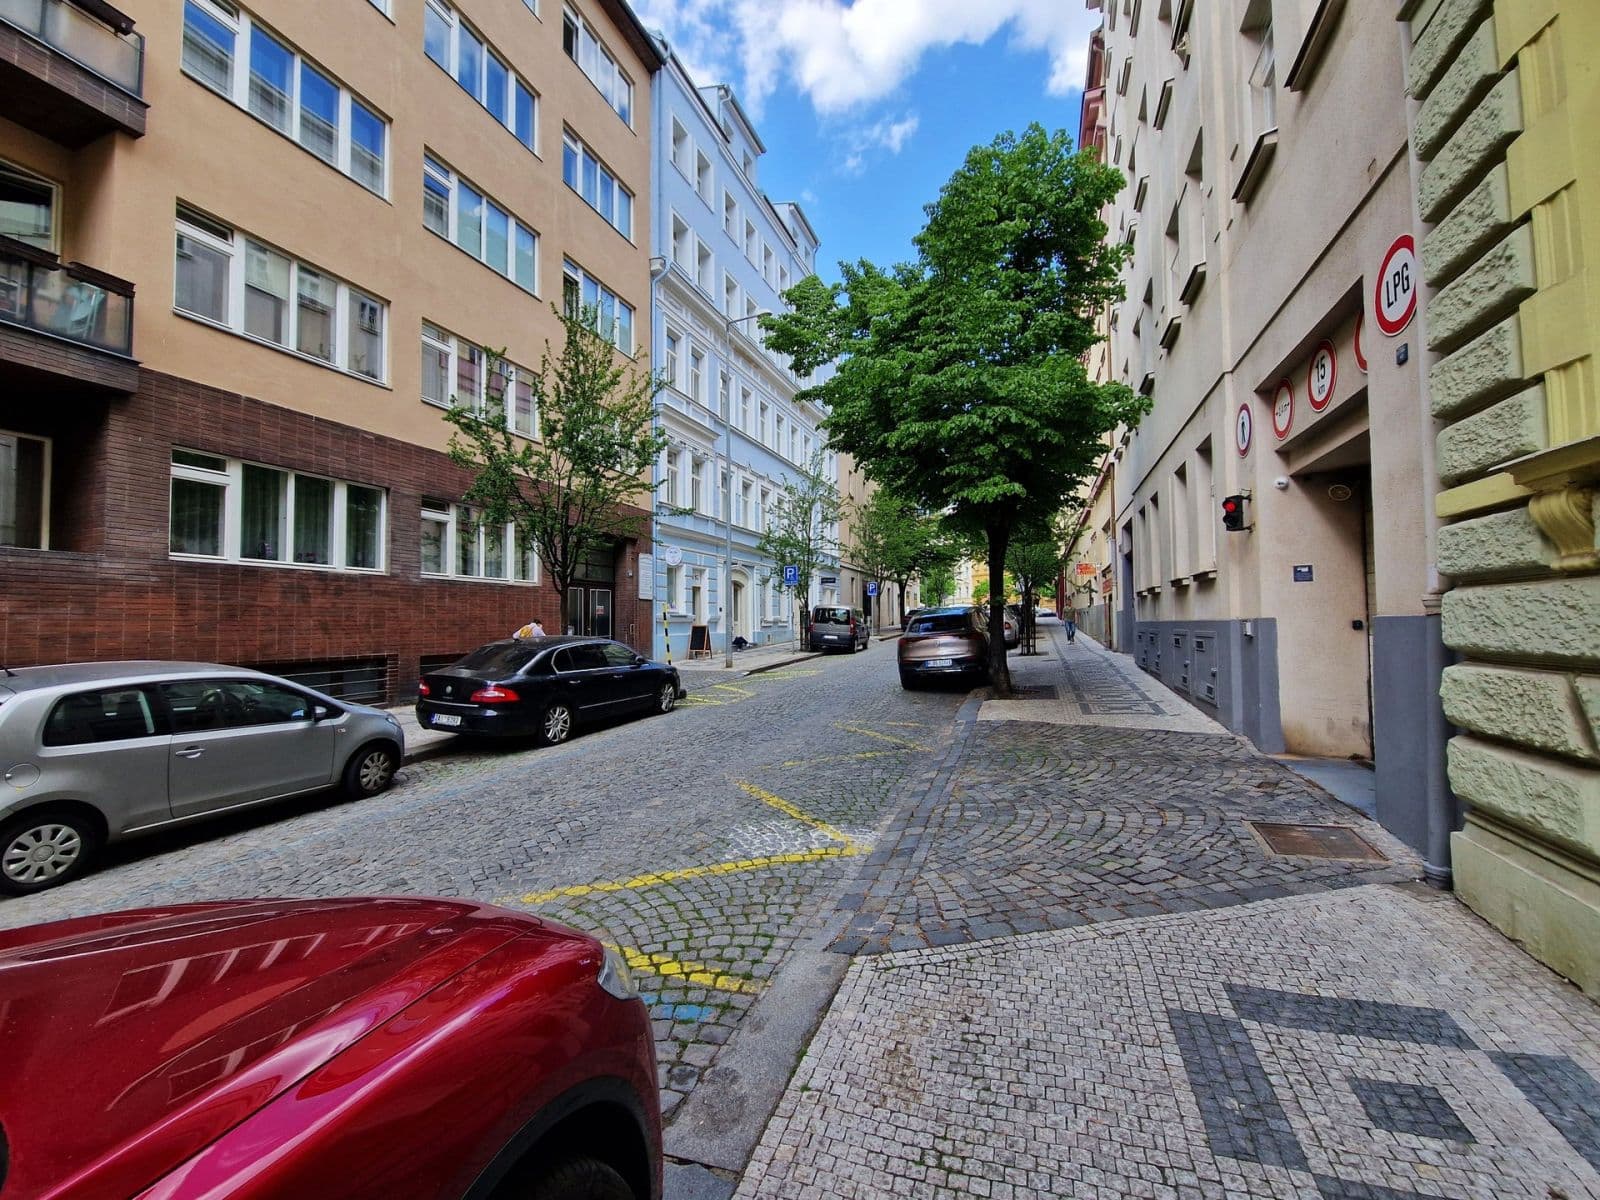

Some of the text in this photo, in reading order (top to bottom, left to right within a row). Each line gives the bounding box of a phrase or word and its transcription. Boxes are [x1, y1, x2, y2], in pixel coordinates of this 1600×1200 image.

[1386, 262, 1409, 308] LPG
[1315, 355, 1326, 382] 15
[787, 568, 794, 579] P
